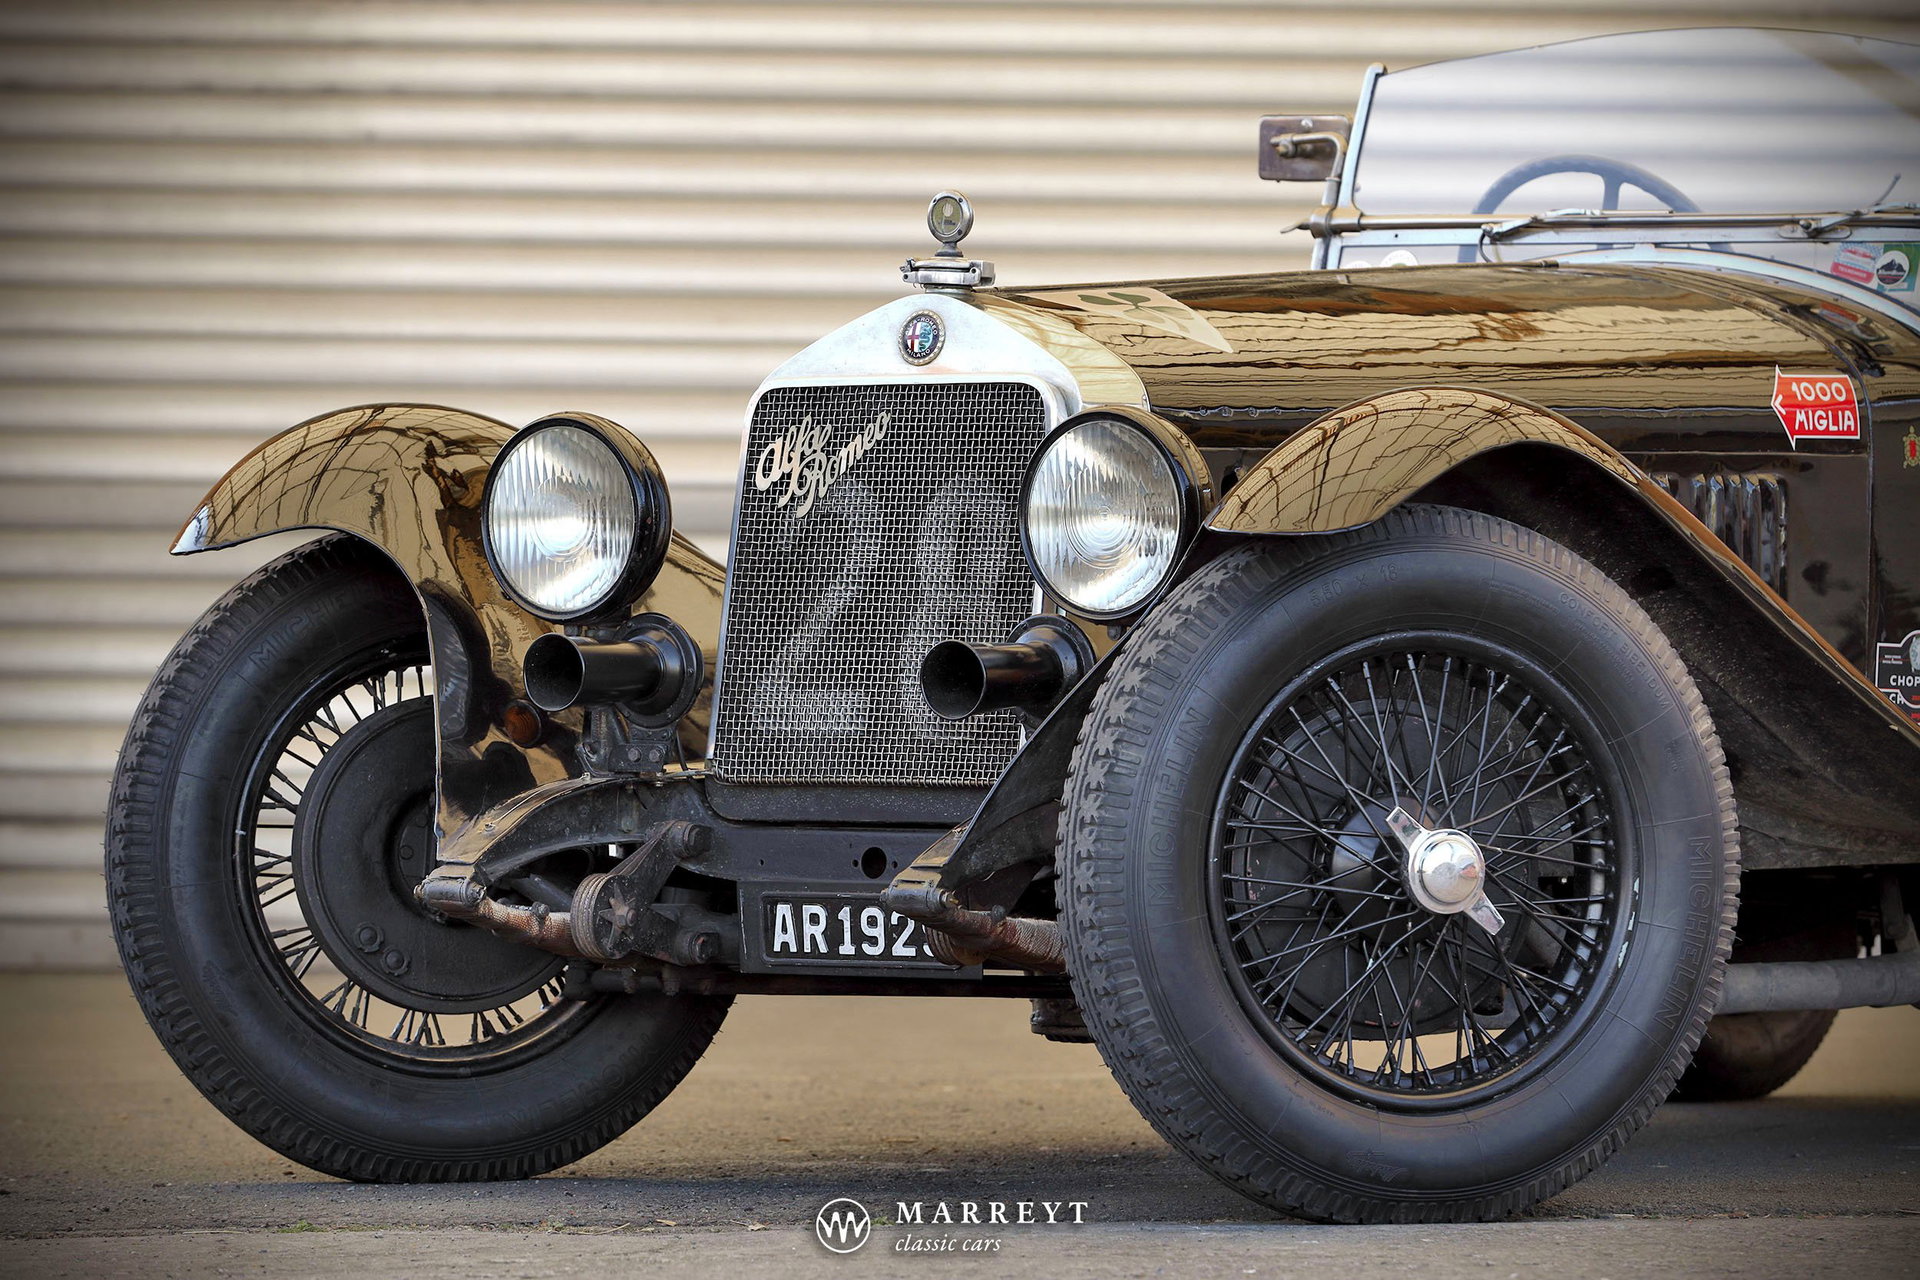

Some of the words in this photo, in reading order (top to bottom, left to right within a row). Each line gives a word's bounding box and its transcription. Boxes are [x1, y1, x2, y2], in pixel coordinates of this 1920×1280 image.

[906, 347, 931, 358] MILANO
[1791, 381, 1847, 402] 1000
[1794, 409, 1855, 432] MIGLIA
[796, 411, 892, 519] Romeo
[1558, 591, 1618, 639] CONFORT
[1148, 706, 1214, 905] MICHELIN
[773, 902, 935, 958] AR192
[1653, 835, 1713, 1031] MICHELIN
